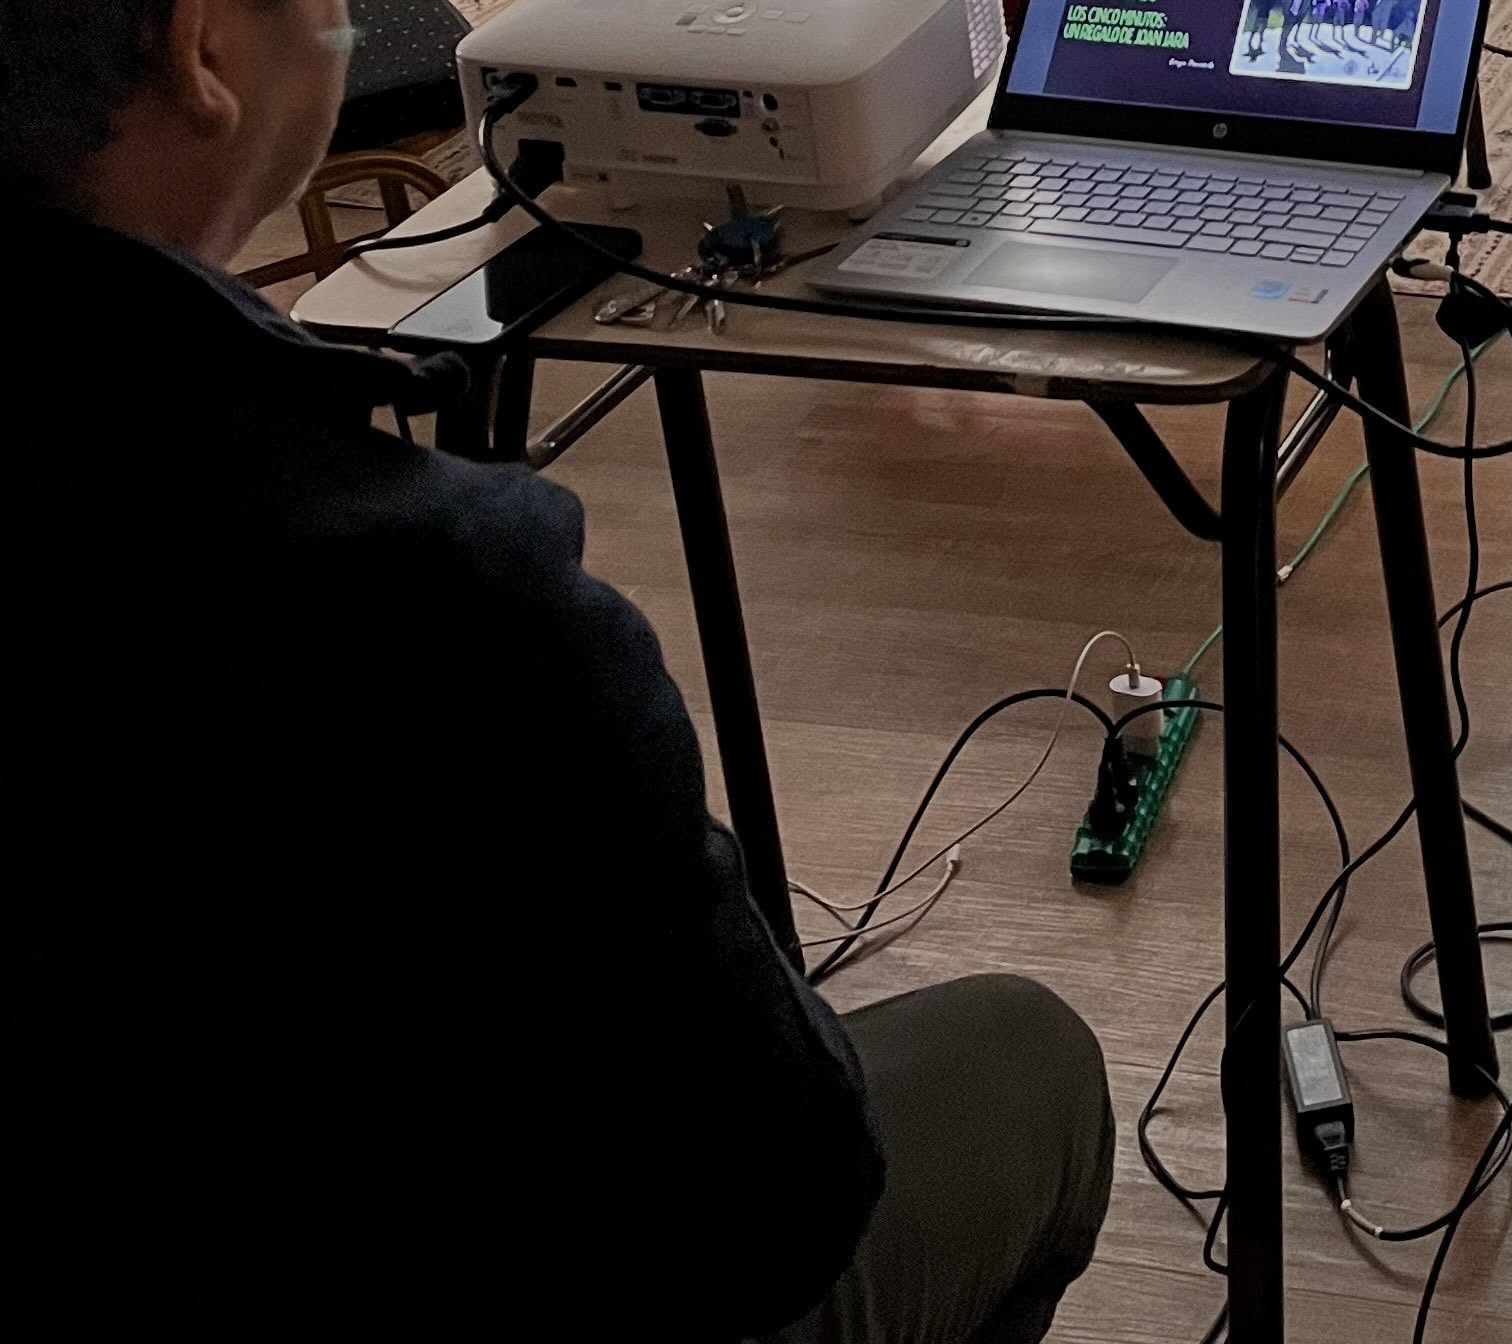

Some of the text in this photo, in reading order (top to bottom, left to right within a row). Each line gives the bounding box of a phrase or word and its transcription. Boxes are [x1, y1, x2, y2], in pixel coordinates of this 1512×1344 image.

[1067, 4, 1087, 22] LOS
[1088, 6, 1120, 25] CINCO
[1064, 23, 1190, 49] UN REGALO DE JOAN JARA
